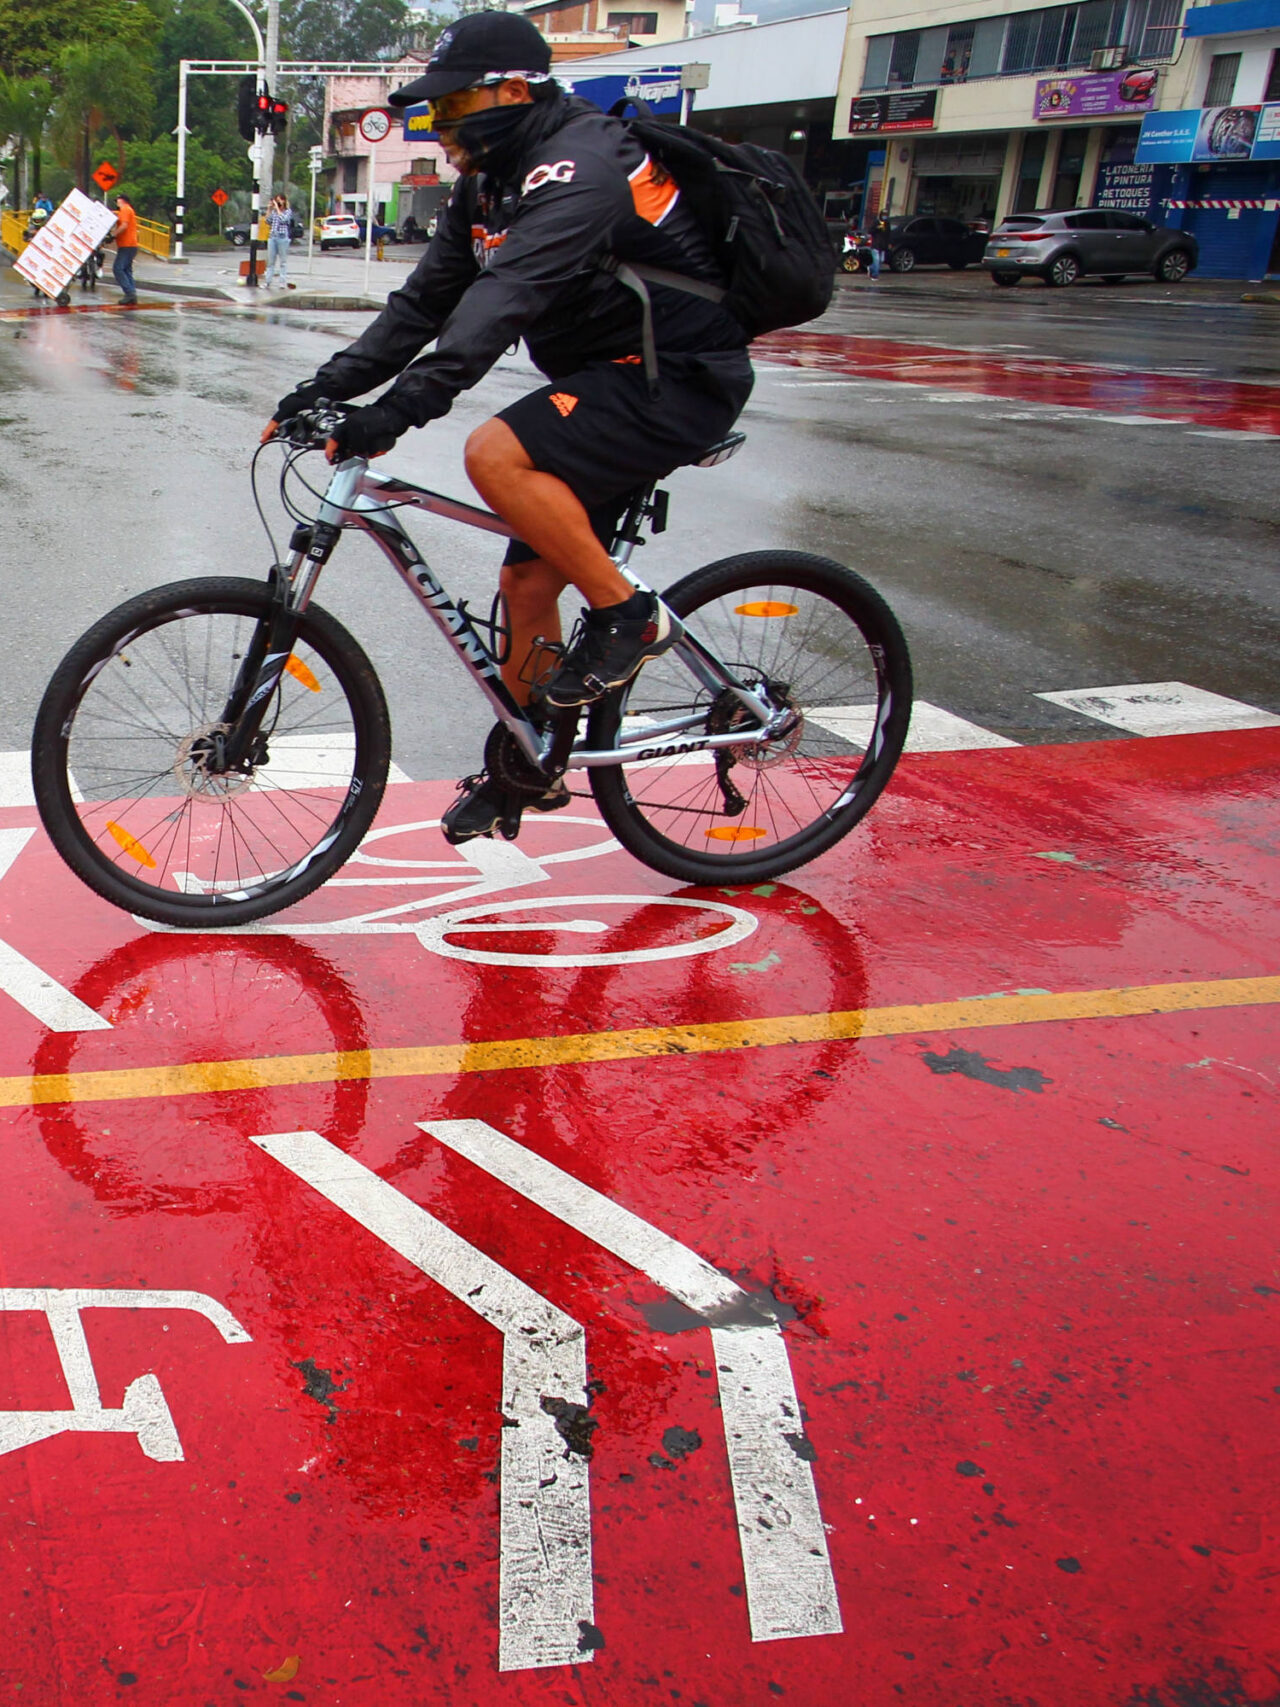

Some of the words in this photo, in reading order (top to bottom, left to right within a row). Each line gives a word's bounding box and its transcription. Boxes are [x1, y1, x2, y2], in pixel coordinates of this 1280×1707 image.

[1113, 174, 1153, 185] PINTURA
[408, 563, 502, 680] GIANT
[637, 739, 710, 761] GIANT
